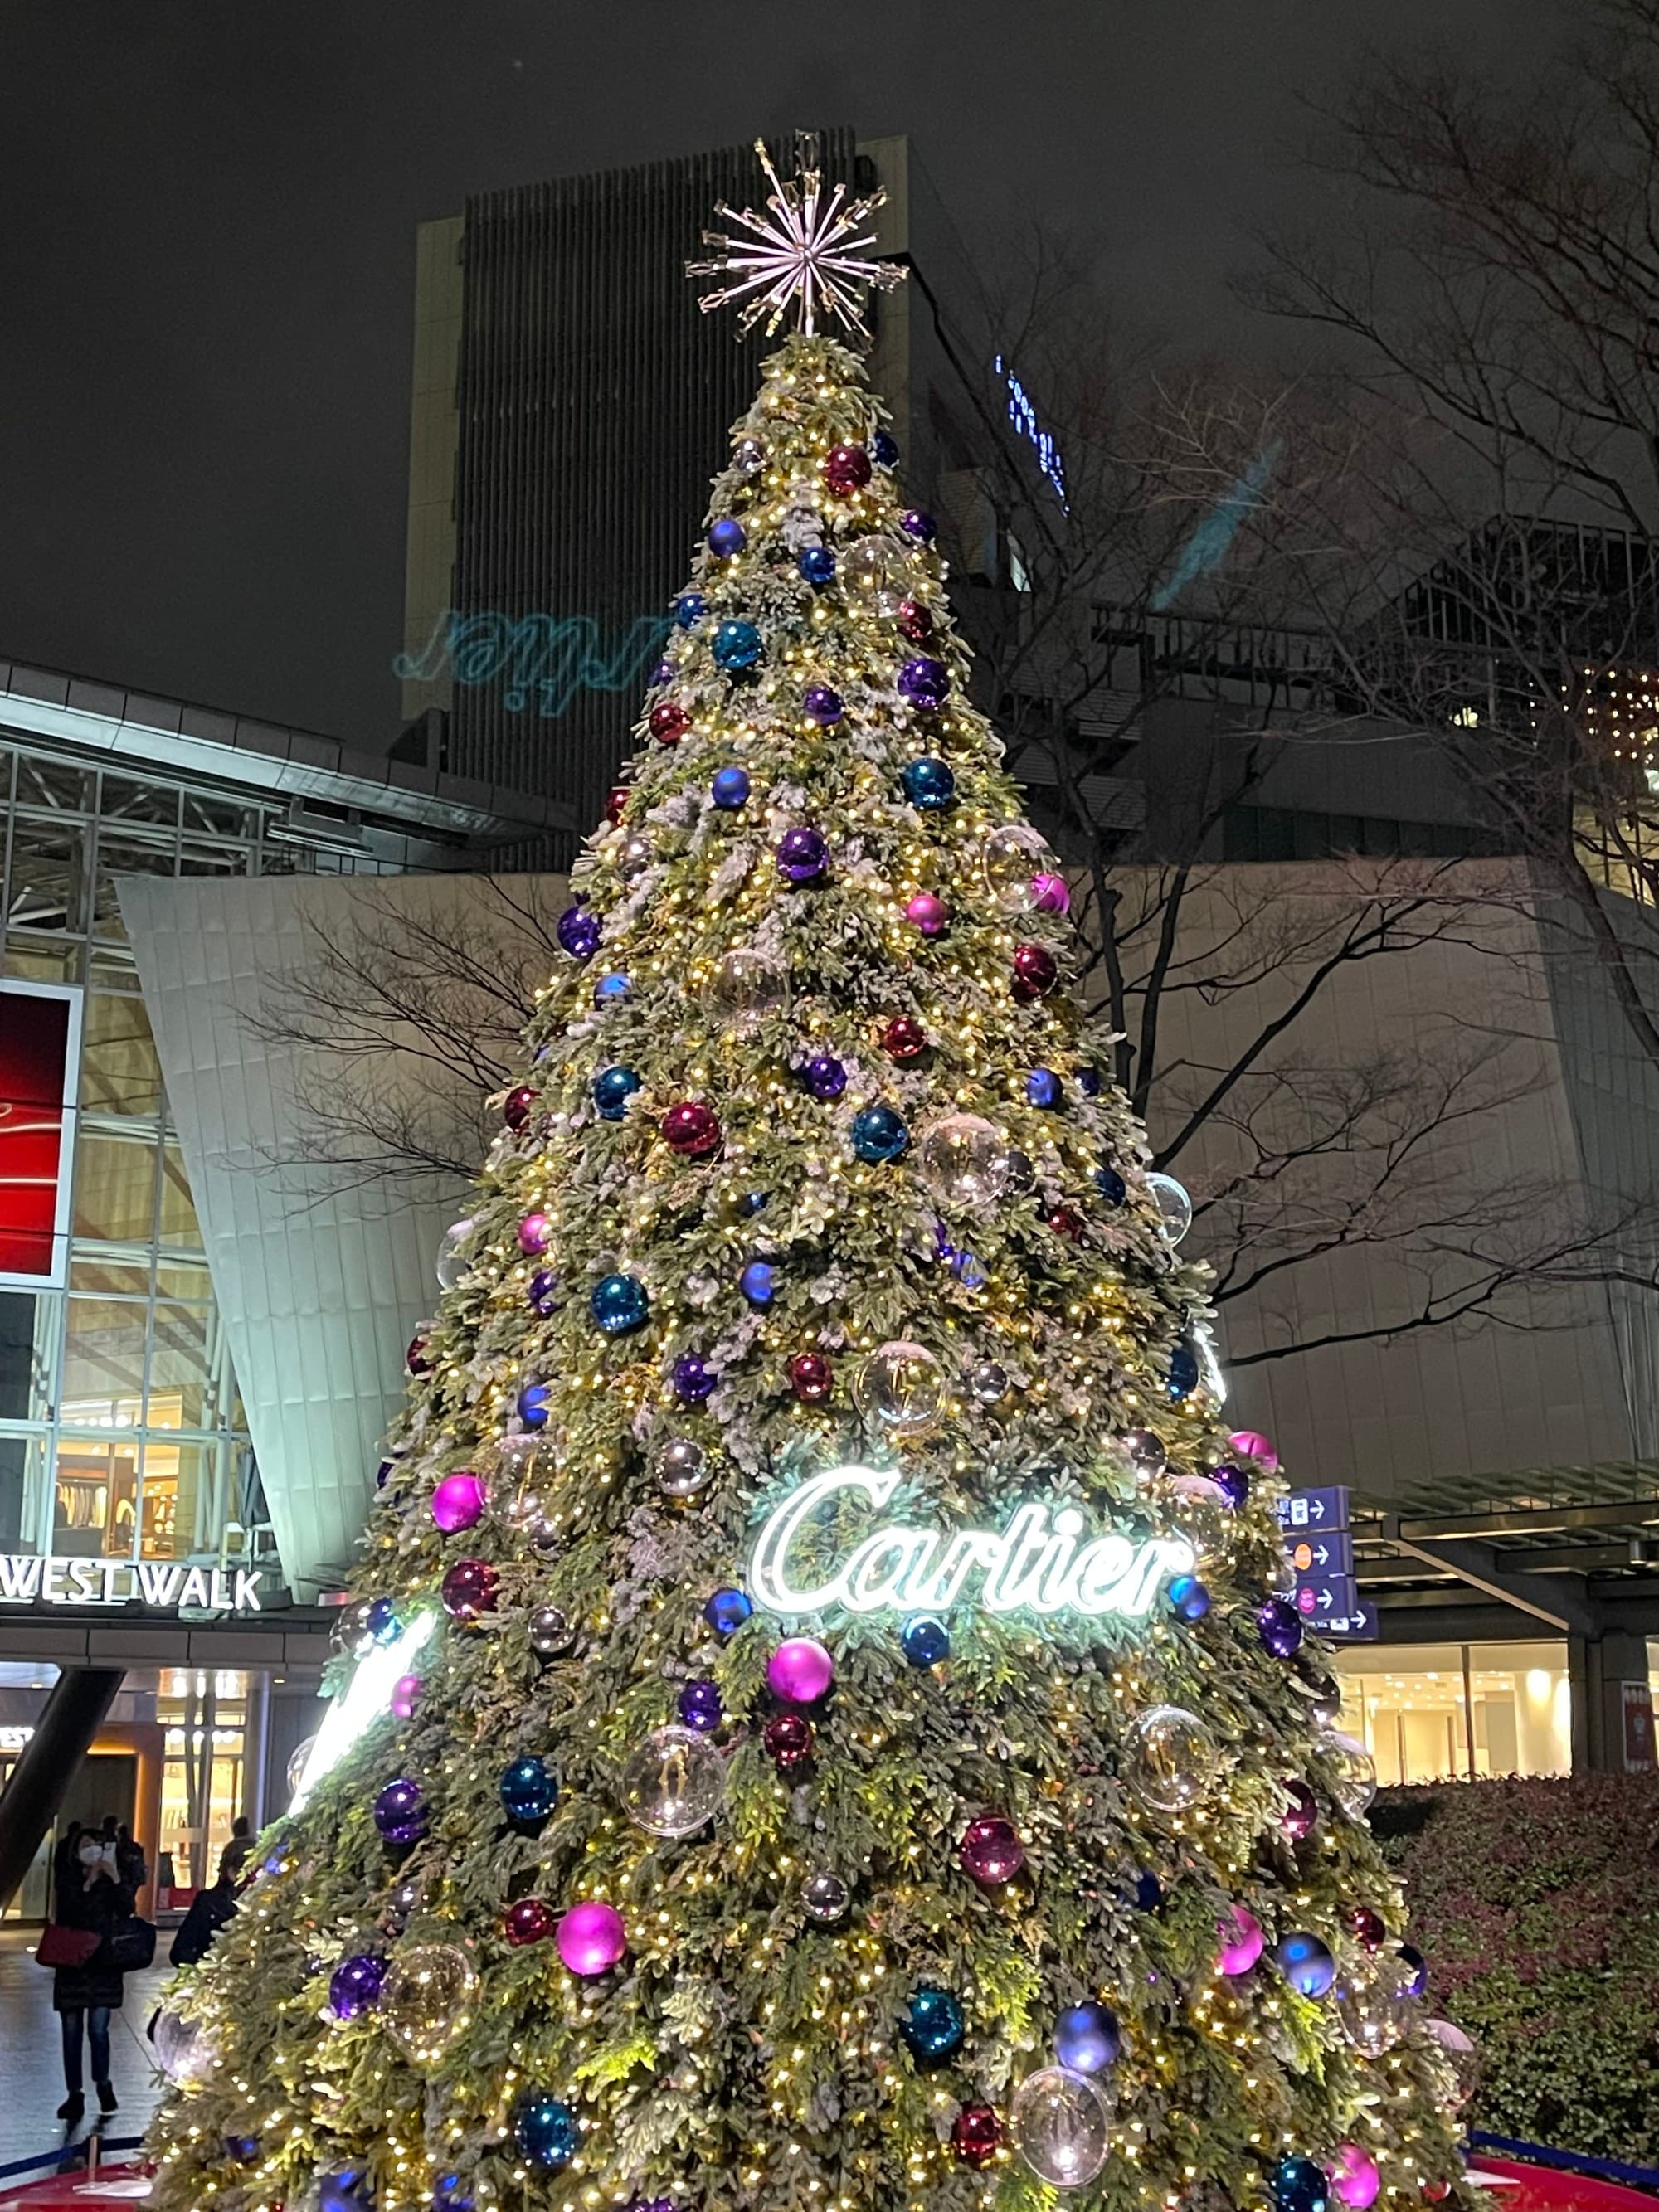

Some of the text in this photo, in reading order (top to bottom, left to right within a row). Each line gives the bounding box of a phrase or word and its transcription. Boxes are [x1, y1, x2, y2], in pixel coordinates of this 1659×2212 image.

[0, 1556, 263, 1612] WEST WALK
[749, 1466, 1195, 1615] Cartier
